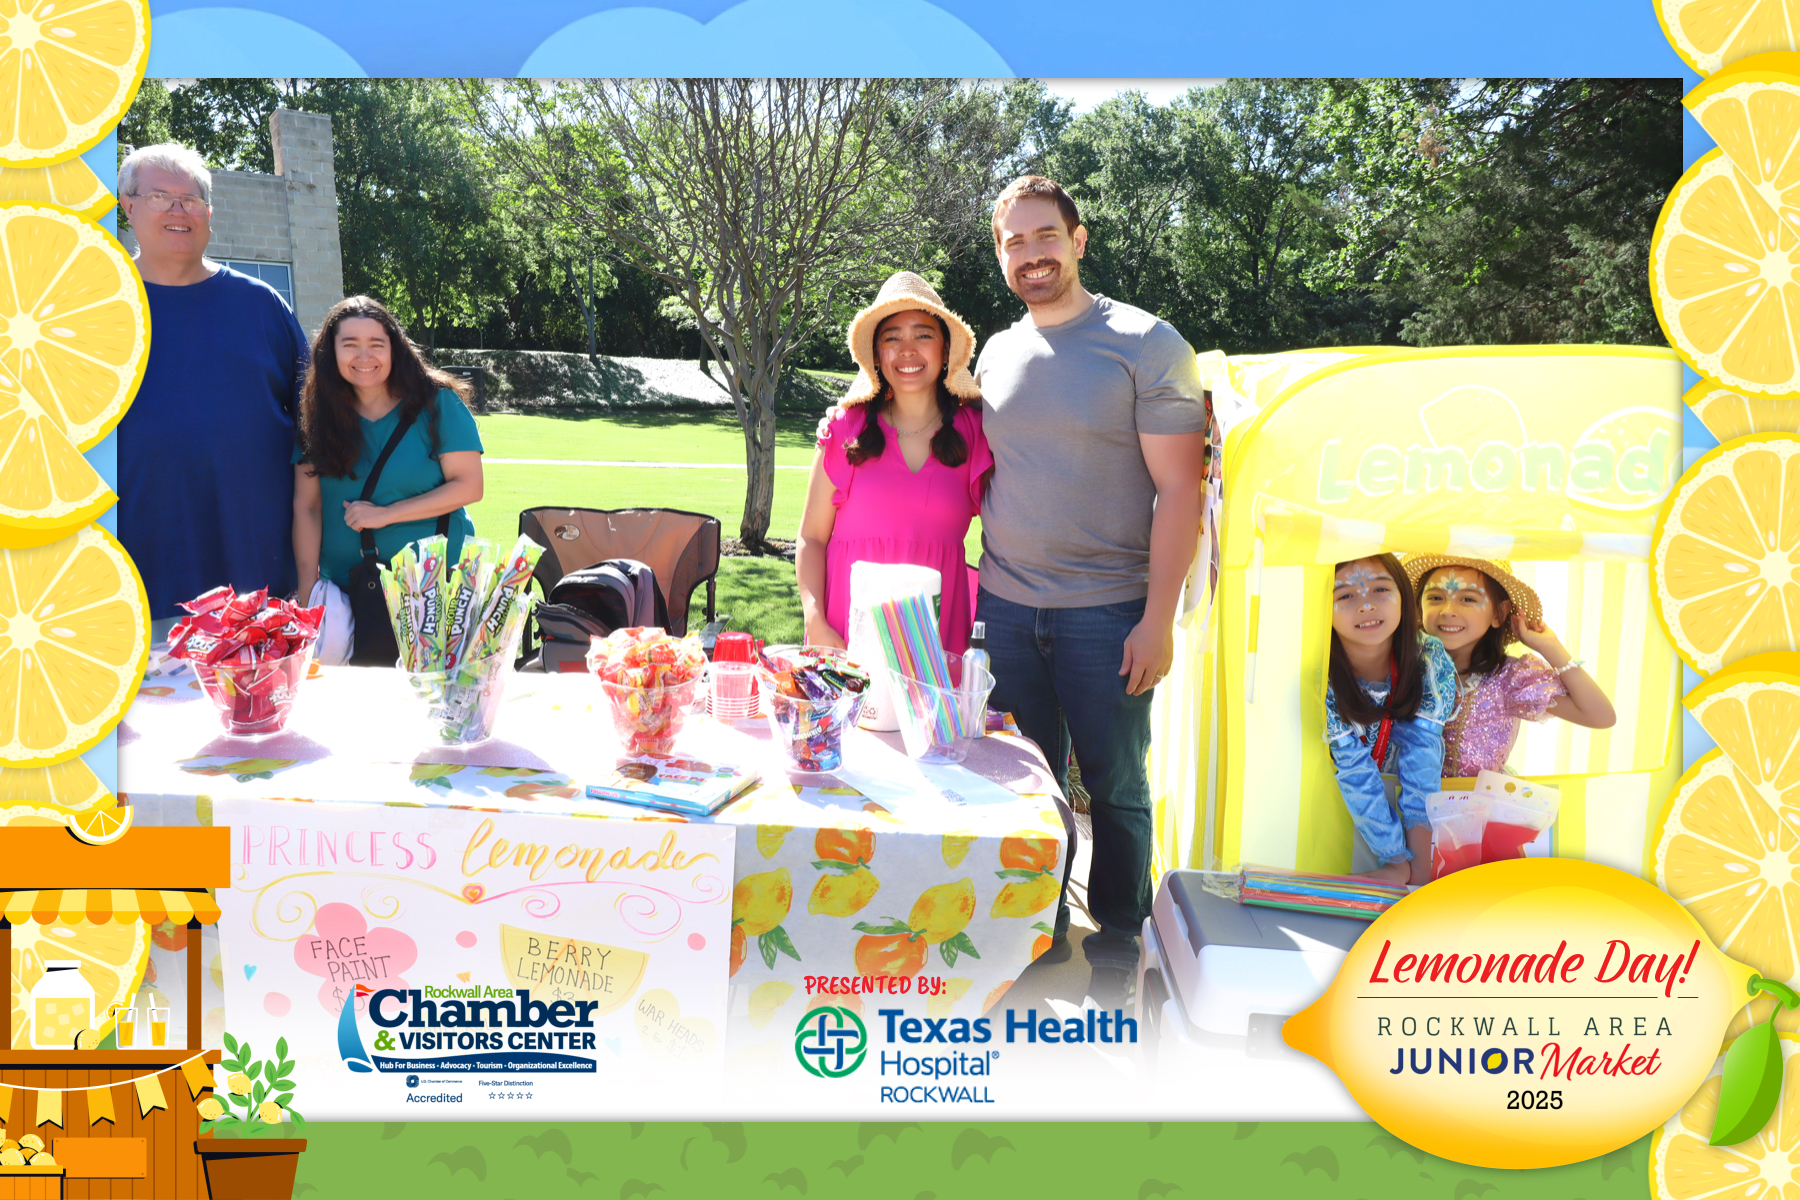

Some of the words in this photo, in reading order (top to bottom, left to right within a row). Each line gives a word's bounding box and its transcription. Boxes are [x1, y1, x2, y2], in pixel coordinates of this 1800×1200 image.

[422, 589, 436, 635] PUNCH
[446, 596, 459, 626] SOUR
[451, 587, 473, 636] PUNCH
[486, 586, 514, 632] PUNCH
[243, 825, 437, 870] PRINCESS
[462, 818, 719, 883] lemonade
[310, 936, 367, 960] FACE
[327, 955, 391, 982] PAINT
[528, 937, 611, 970] BERRY
[517, 957, 614, 993] LEMONADE
[638, 998, 666, 1027] WAR
[667, 1019, 705, 1053] HEADS
